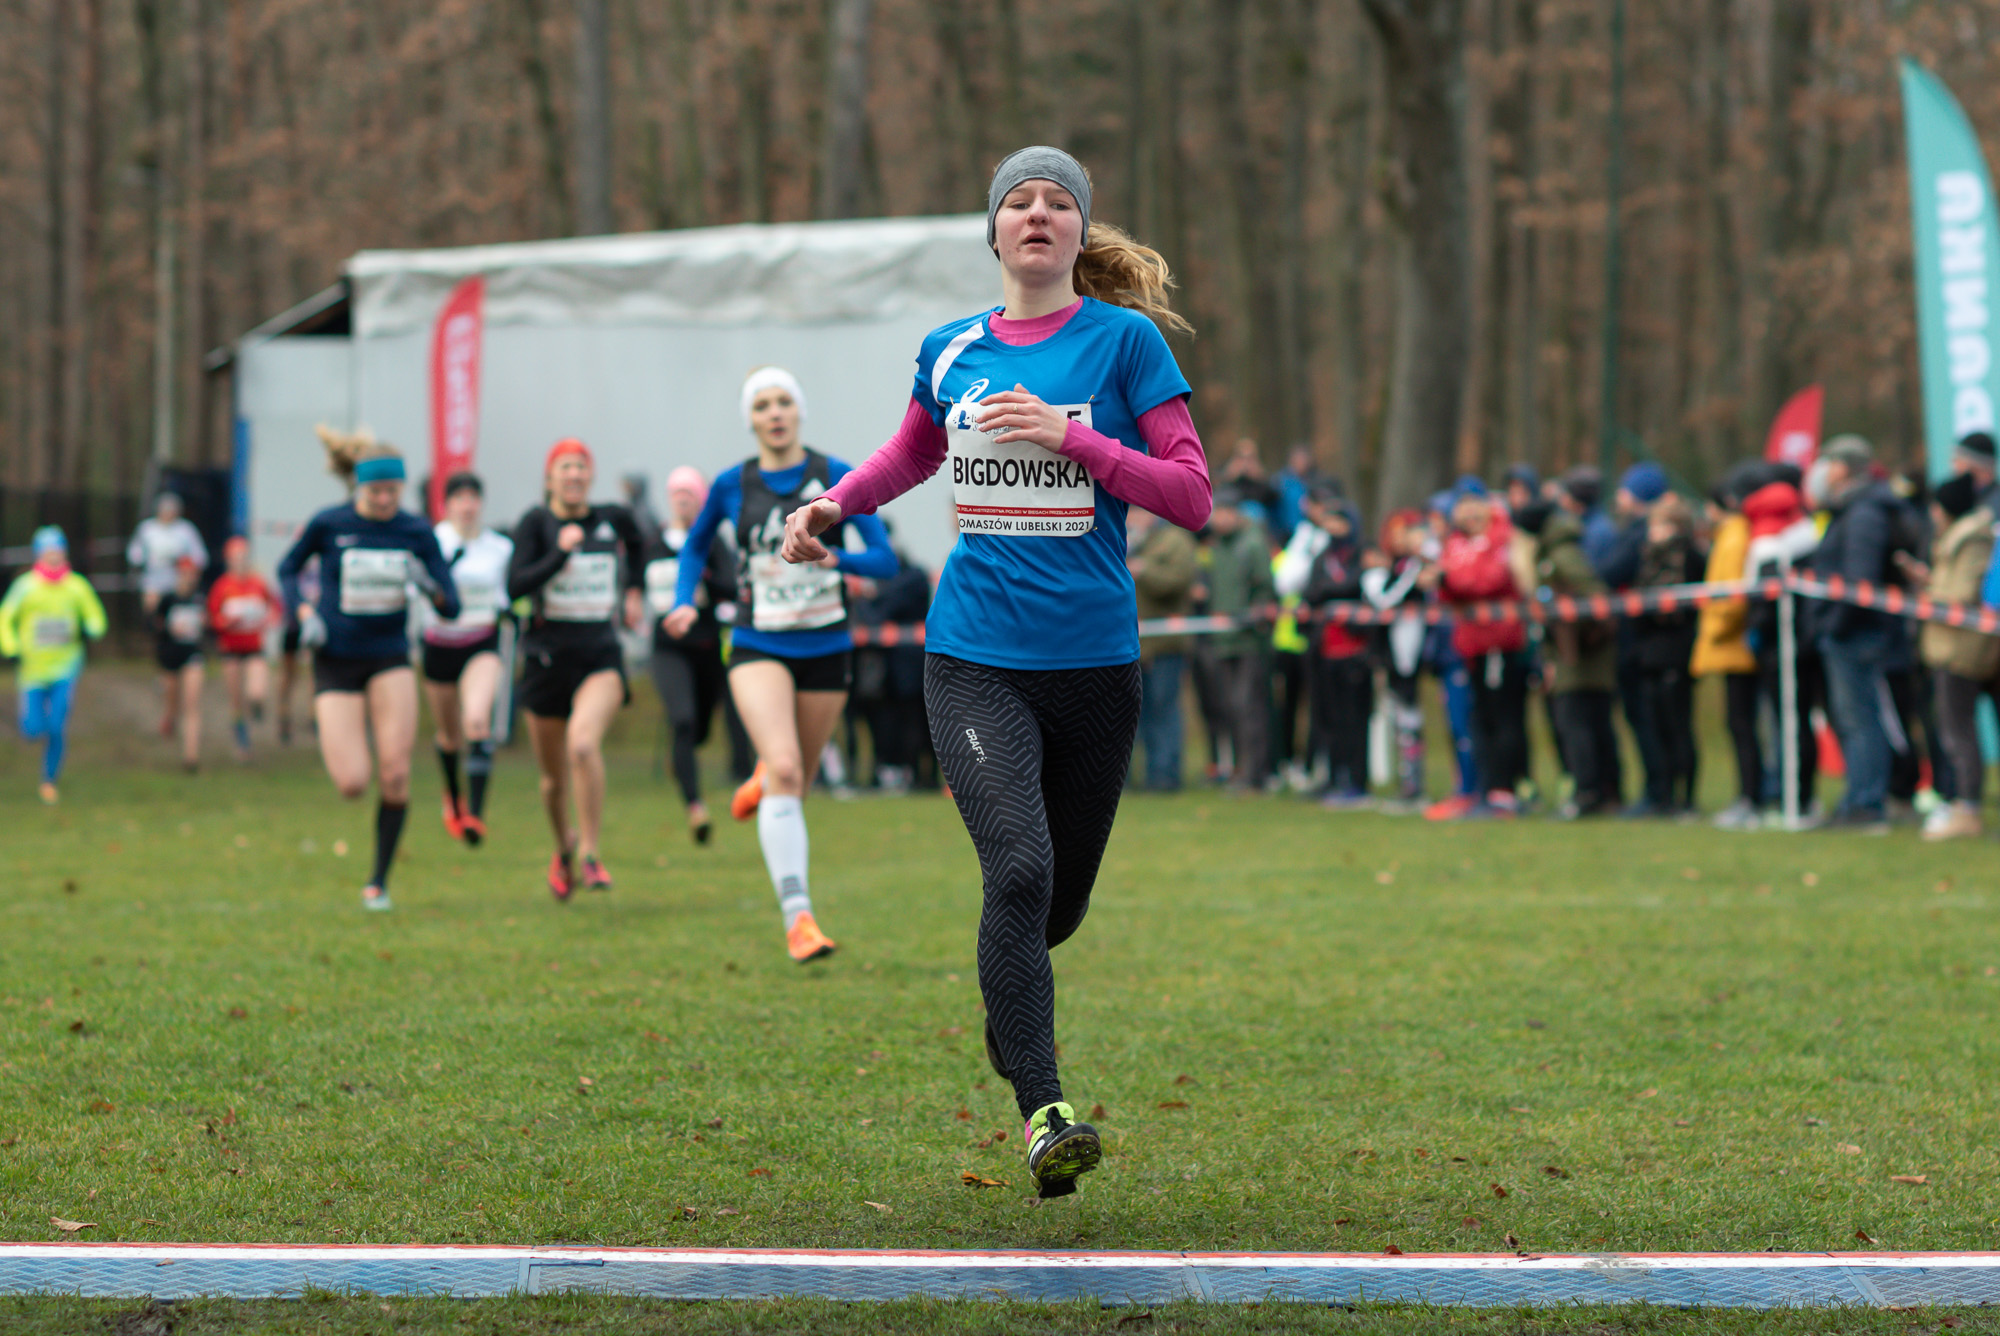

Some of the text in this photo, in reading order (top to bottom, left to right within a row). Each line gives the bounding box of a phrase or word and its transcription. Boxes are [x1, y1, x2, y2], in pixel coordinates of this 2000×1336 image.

[953, 456, 1091, 489] BIGDOWSKA
[958, 518, 1089, 531] OMASZÓW LUBELSKI 2021
[965, 728, 985, 756] CRAFT
